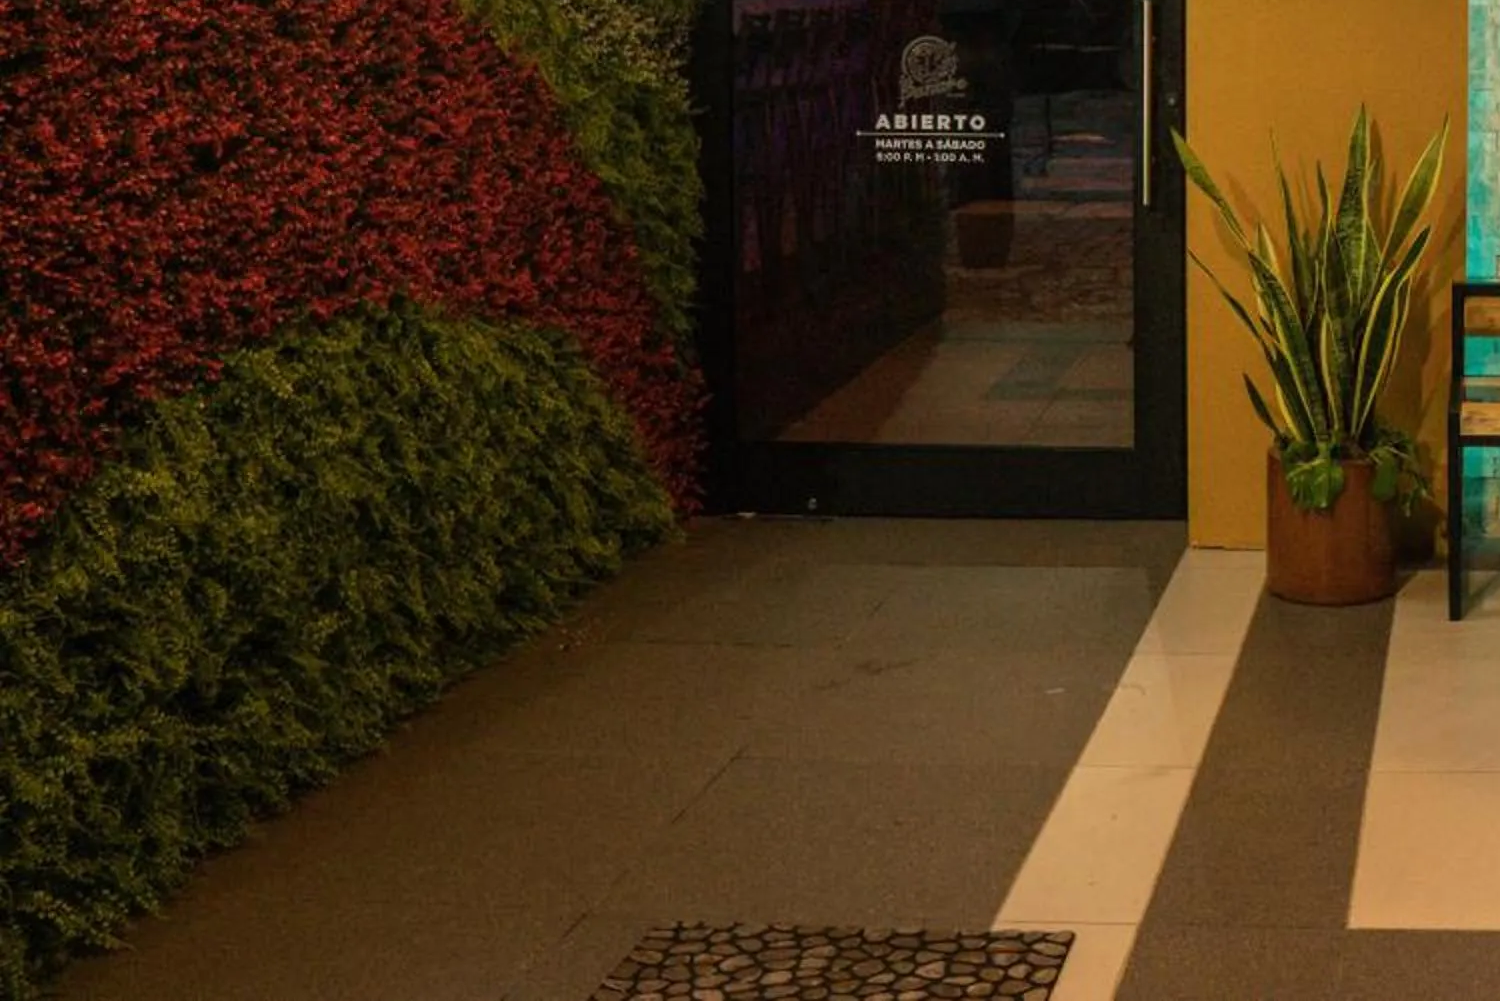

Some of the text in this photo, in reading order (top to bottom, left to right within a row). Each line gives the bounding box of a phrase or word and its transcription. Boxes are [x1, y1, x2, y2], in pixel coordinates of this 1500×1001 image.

[874, 113, 987, 131] ABIERTO
[875, 138, 923, 150] MARTES
[925, 139, 935, 150] A
